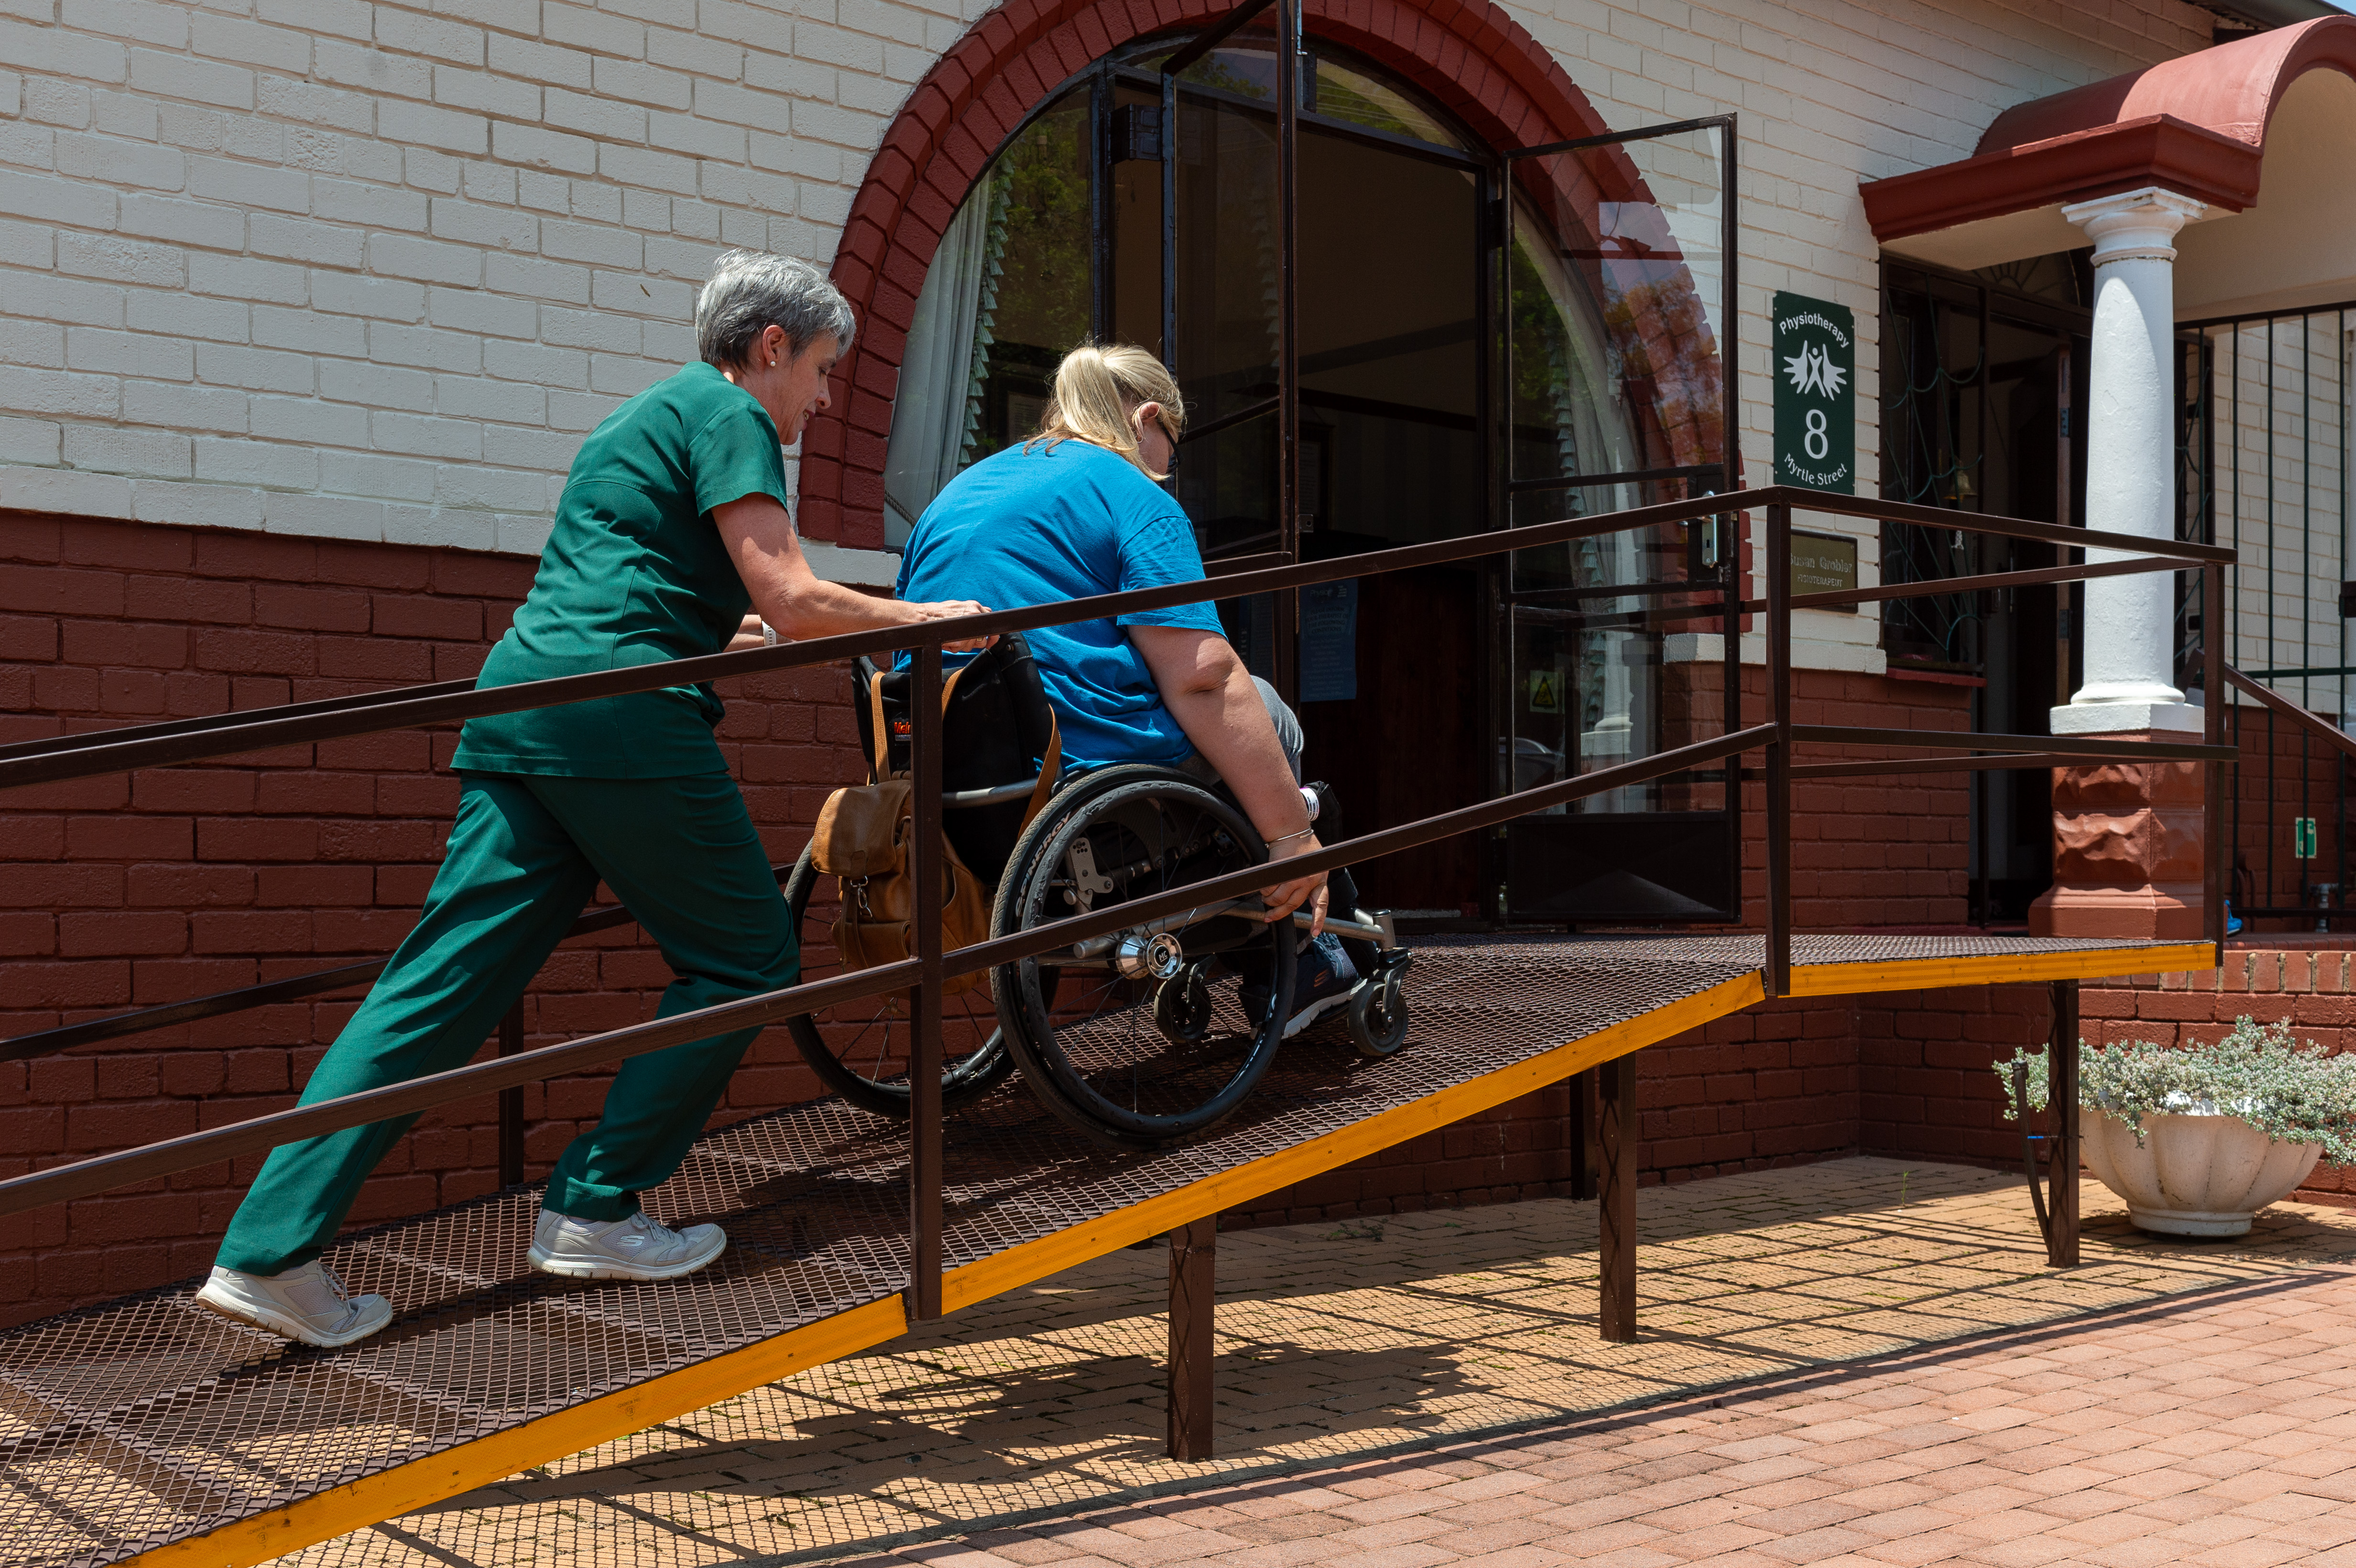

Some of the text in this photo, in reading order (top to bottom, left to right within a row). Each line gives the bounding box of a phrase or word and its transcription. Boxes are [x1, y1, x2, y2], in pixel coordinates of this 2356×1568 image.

[1779, 311, 1849, 348] Physiotherapy
[1804, 409, 1828, 459] 8
[1784, 452, 1847, 485] Myrtle Street
[1797, 574, 1843, 587] FISIOTERAPEUT
[1819, 556, 1853, 573] Grobler
